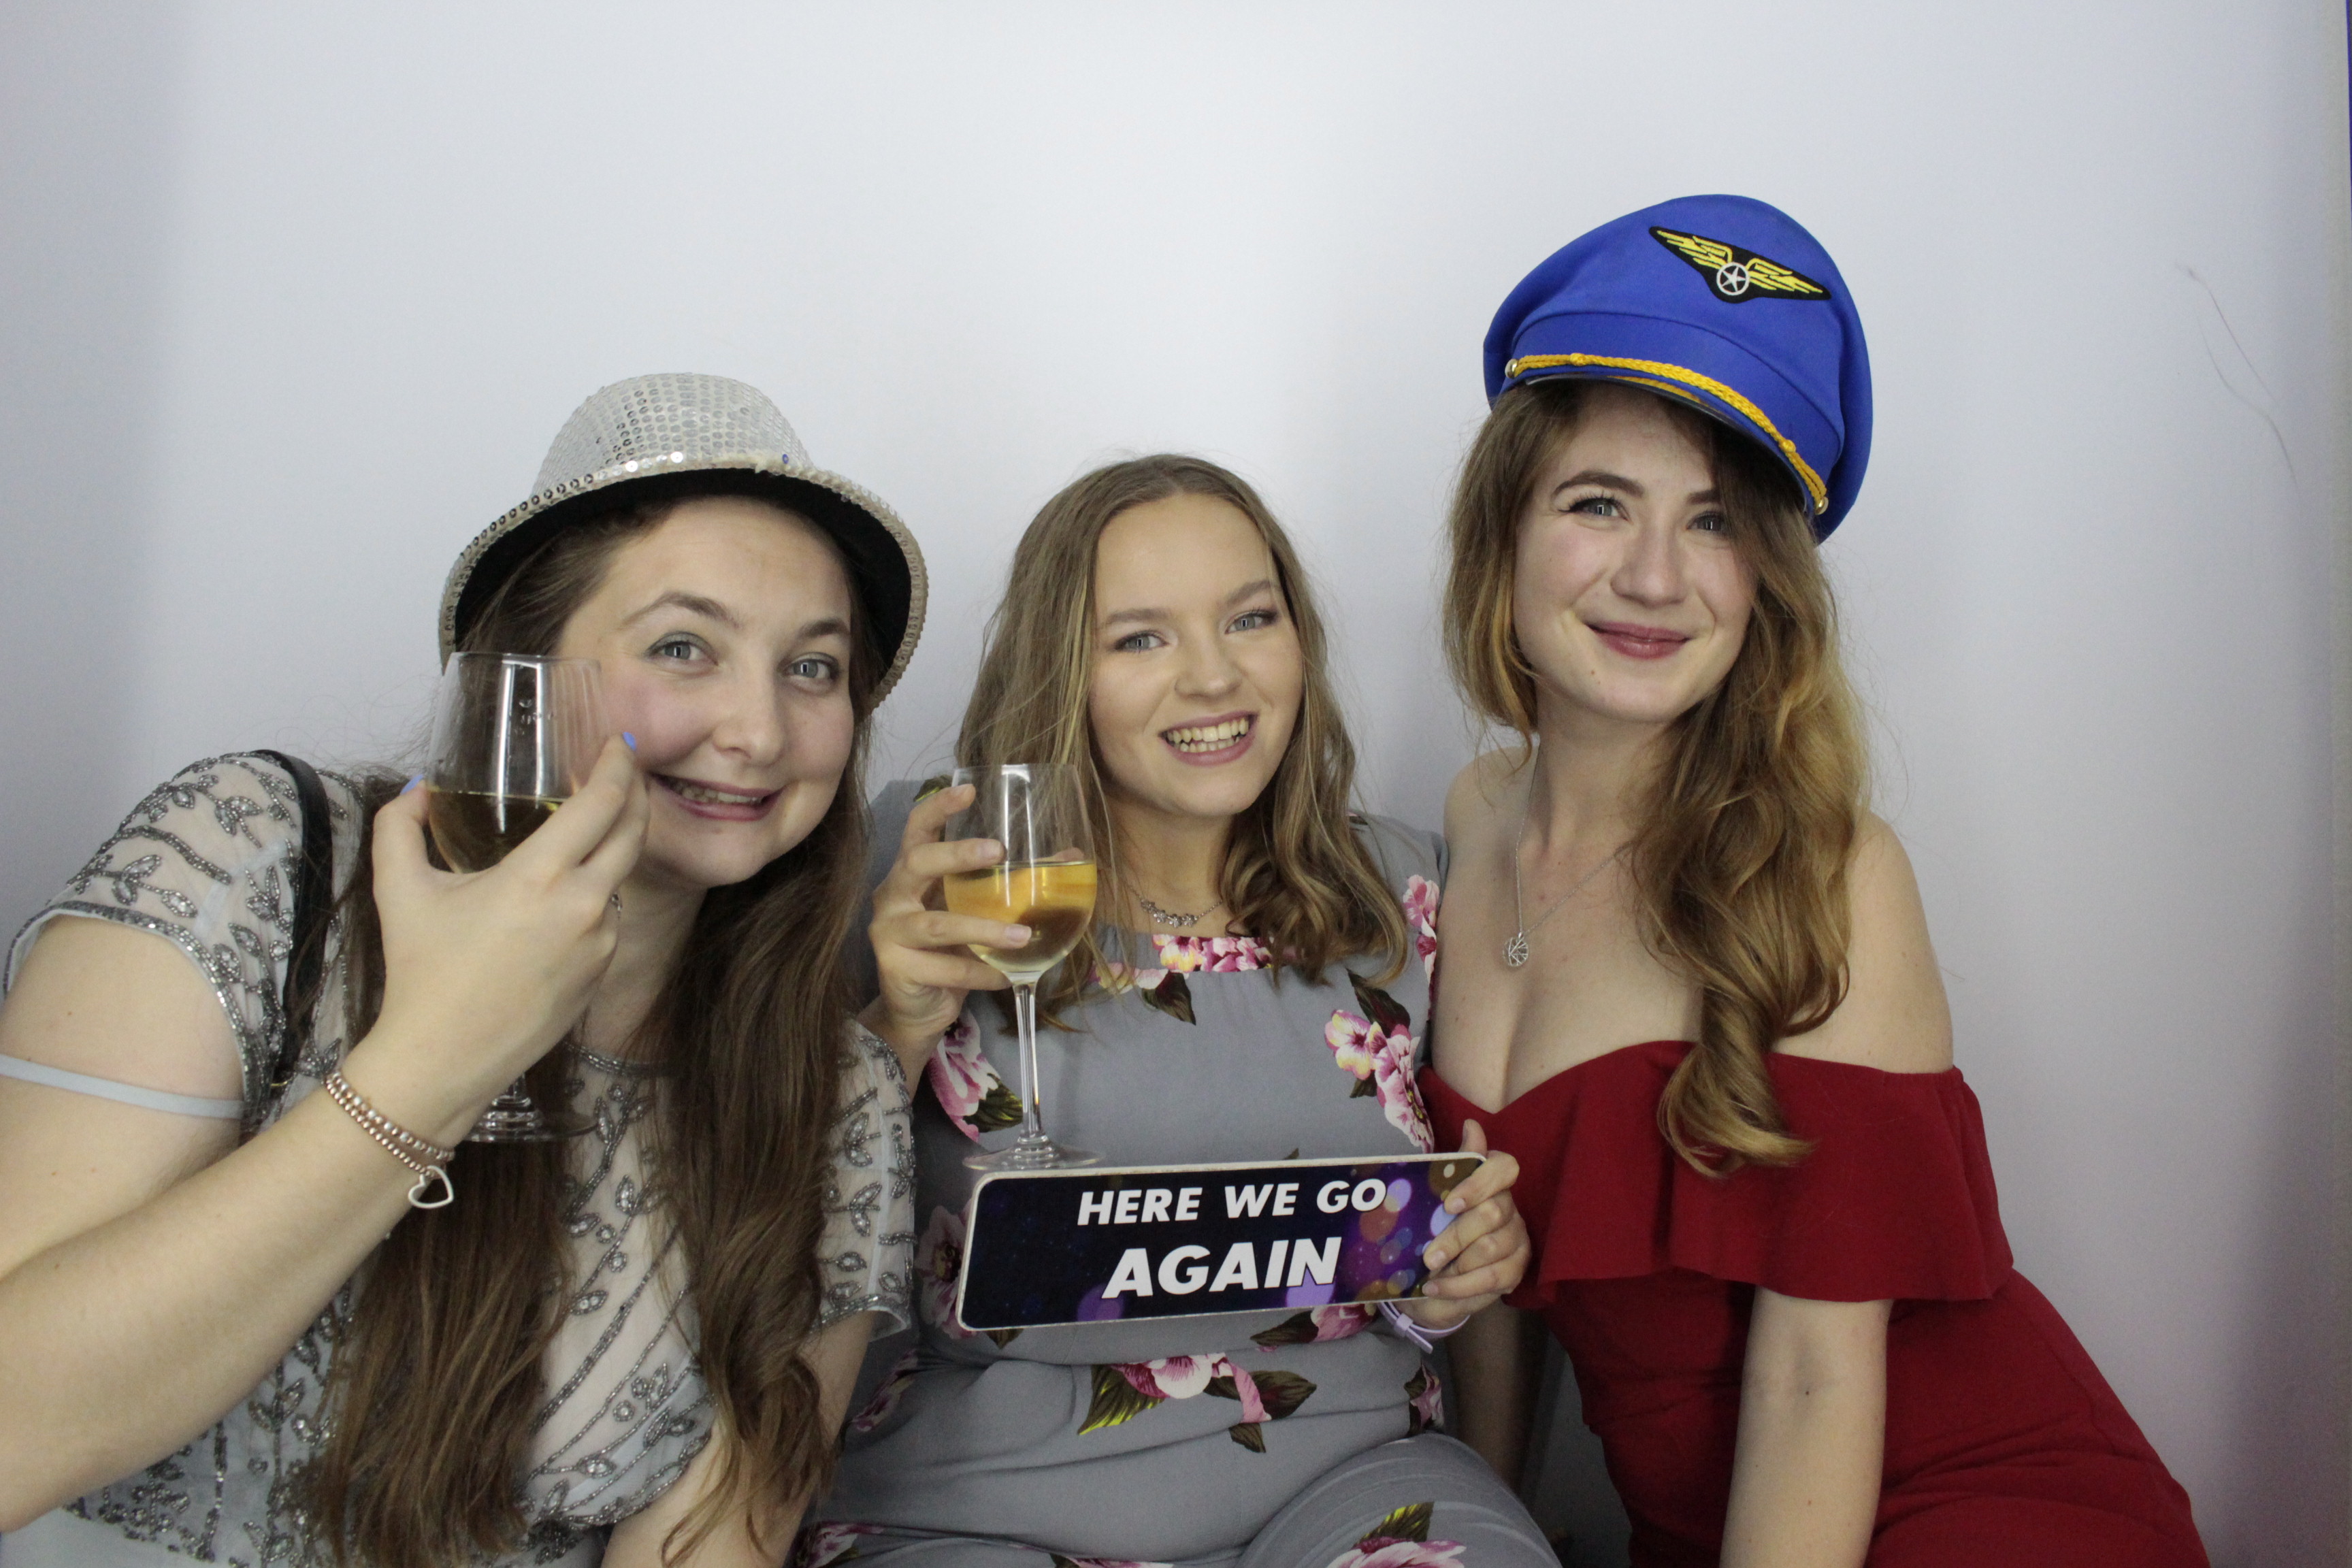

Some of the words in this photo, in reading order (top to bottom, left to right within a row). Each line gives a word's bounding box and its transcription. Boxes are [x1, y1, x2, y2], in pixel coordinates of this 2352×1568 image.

[1077, 1188, 1203, 1225] HERE
[1225, 1183, 1299, 1218] WE
[1317, 1179, 1386, 1213] GO
[1102, 1237, 1342, 1298] AGAIN
